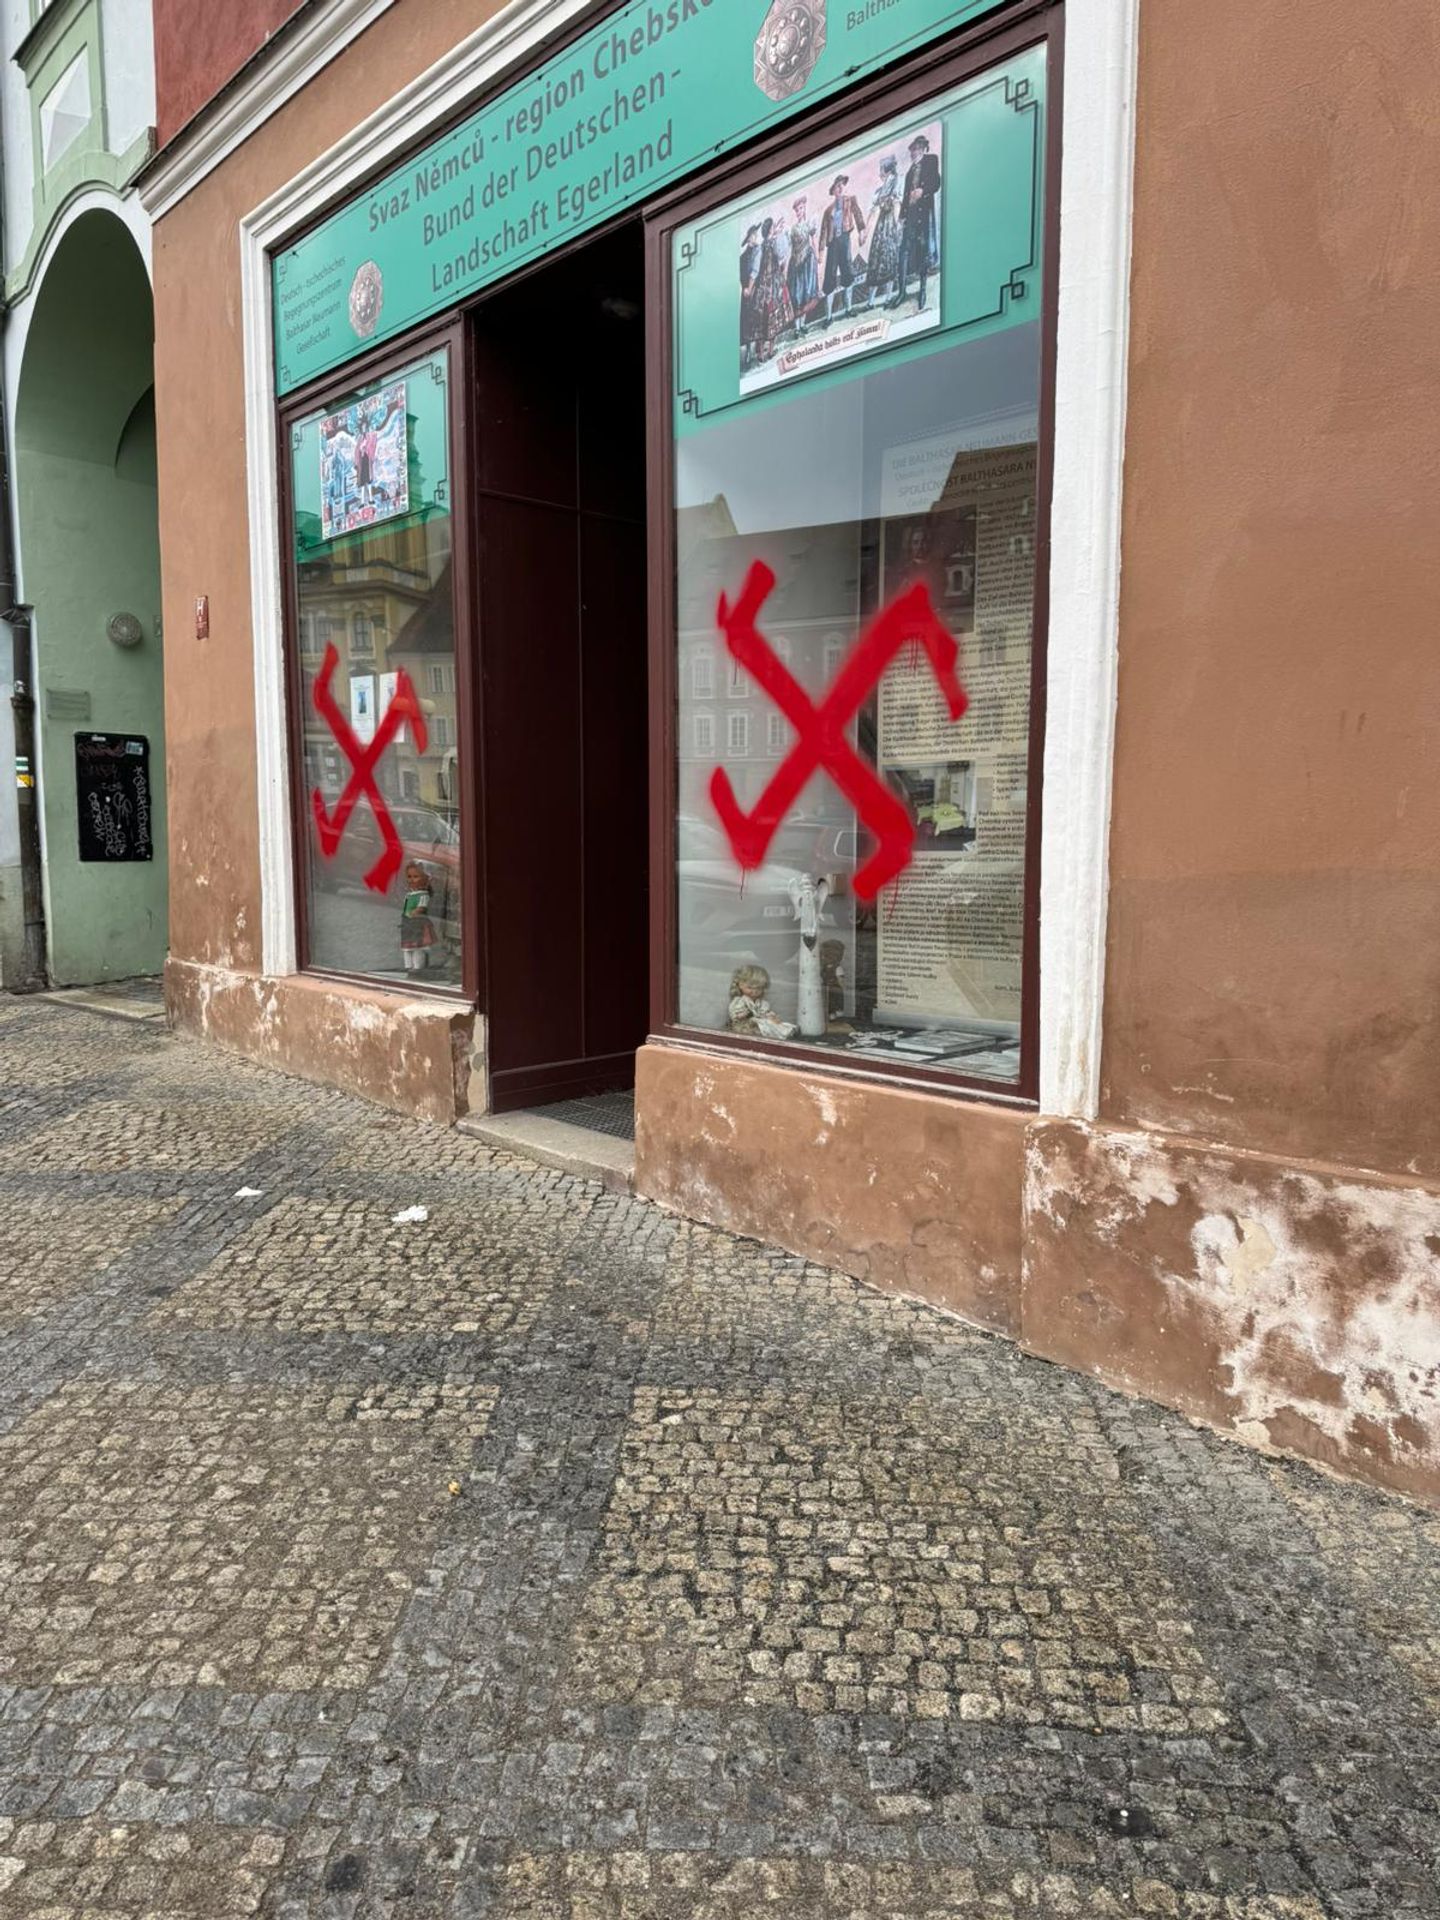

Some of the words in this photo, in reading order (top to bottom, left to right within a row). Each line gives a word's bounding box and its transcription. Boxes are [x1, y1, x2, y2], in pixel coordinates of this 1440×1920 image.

[847, 0, 900, 31] Baltha
[368, 185, 410, 233] Svaz
[416, 129, 485, 202] Němců
[506, 69, 584, 141] region
[593, 0, 714, 79] Chebsk
[423, 184, 475, 246] Bund
[482, 165, 518, 210] der
[526, 70, 665, 182] Deutschen
[433, 199, 549, 293] Landschaft
[557, 118, 673, 229] Egerland
